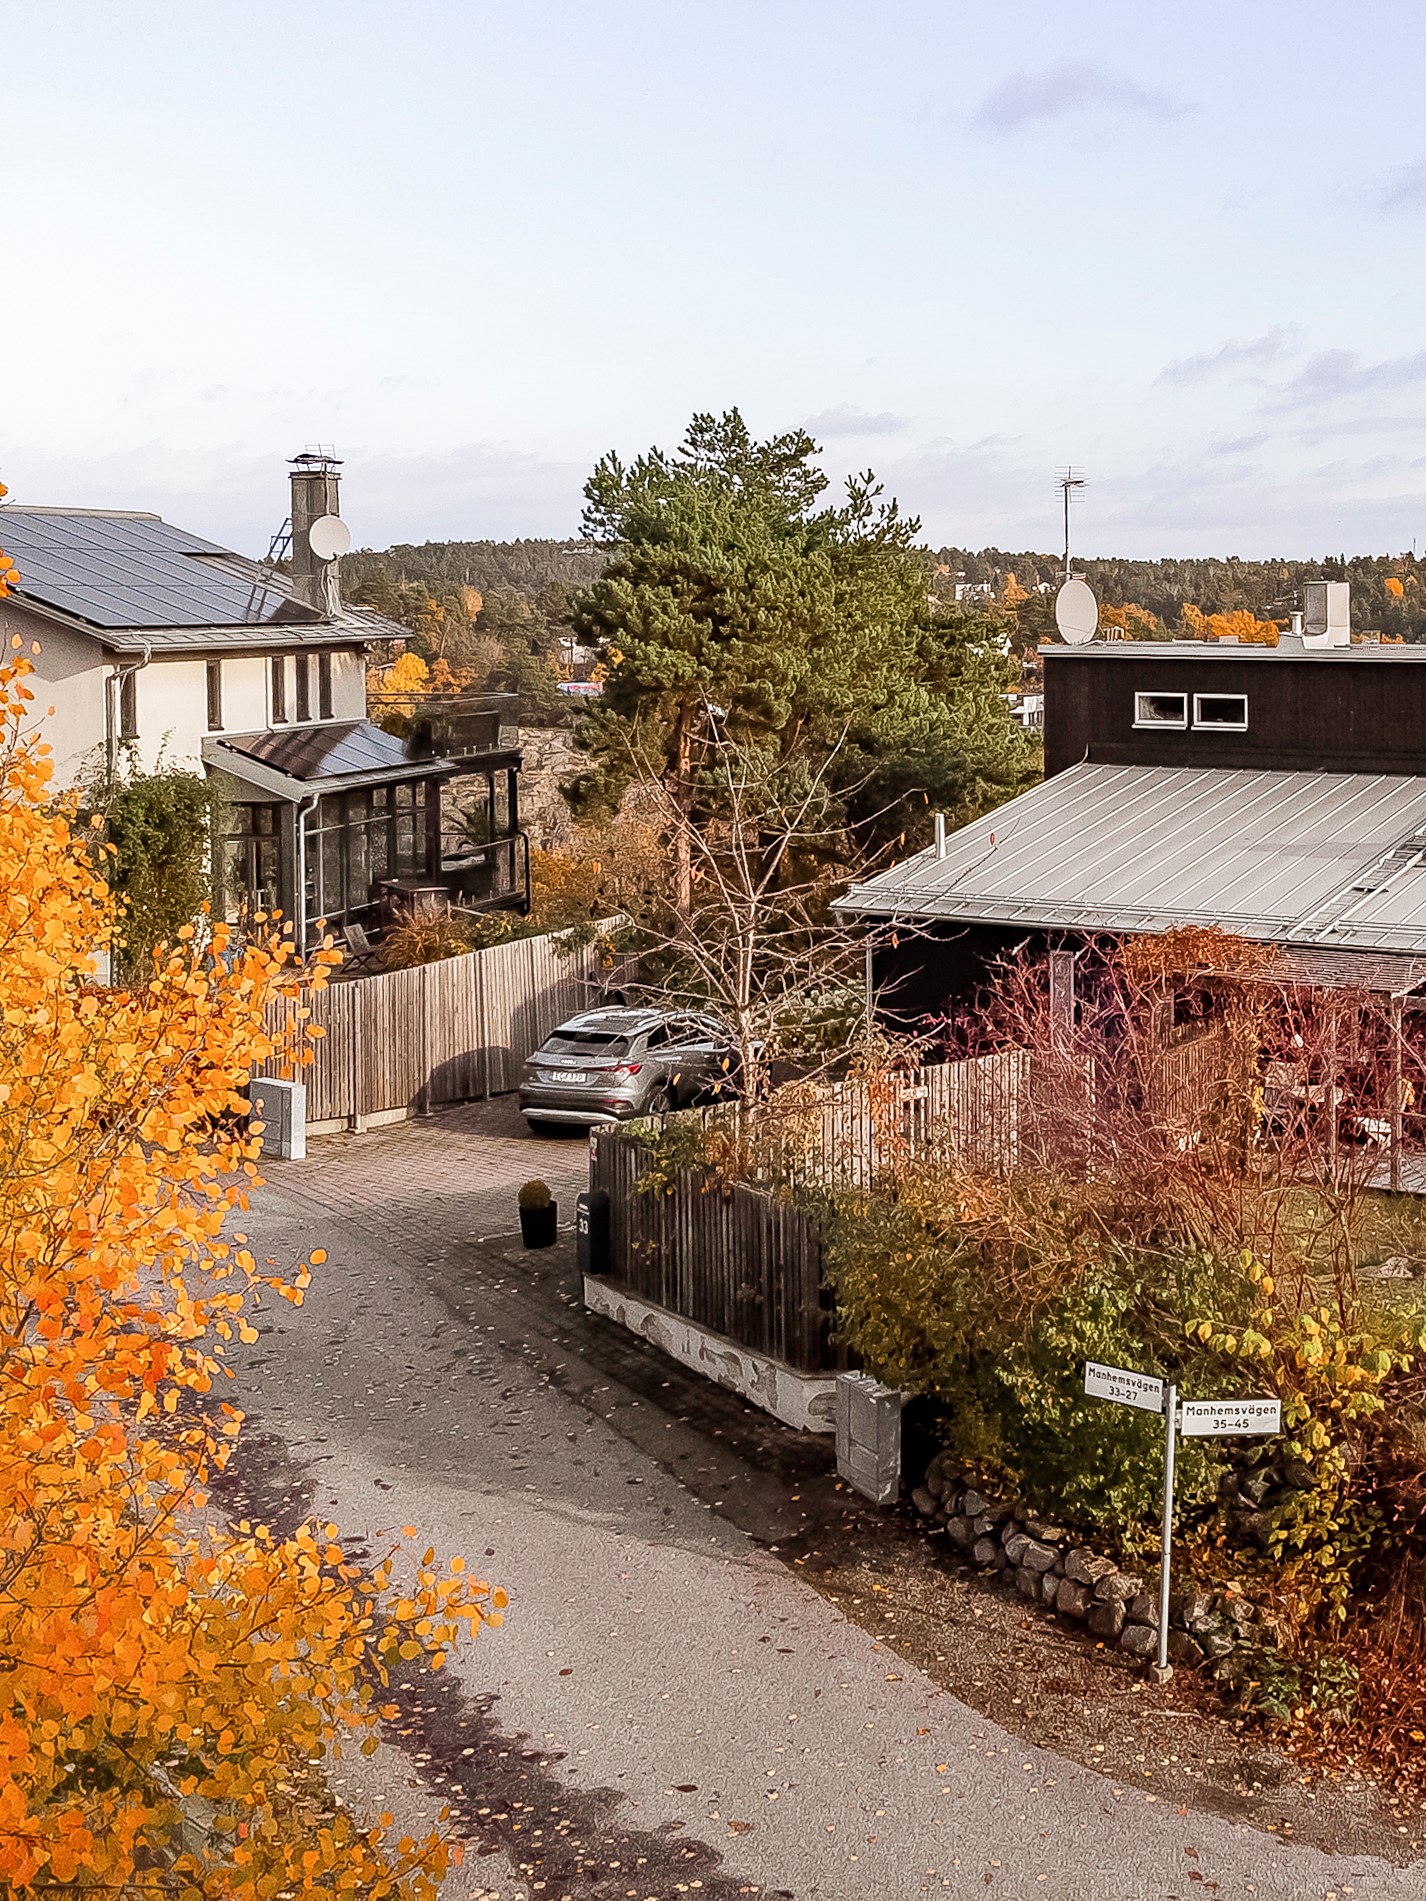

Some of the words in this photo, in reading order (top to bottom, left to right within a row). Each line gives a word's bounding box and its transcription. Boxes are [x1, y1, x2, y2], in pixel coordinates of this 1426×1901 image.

[1088, 1367, 1160, 1394] Manhemsvägen
[1108, 1385, 1138, 1401] 33-27
[1186, 1404, 1277, 1417] Manhemsvägen
[1212, 1419, 1250, 1429] 35-45
